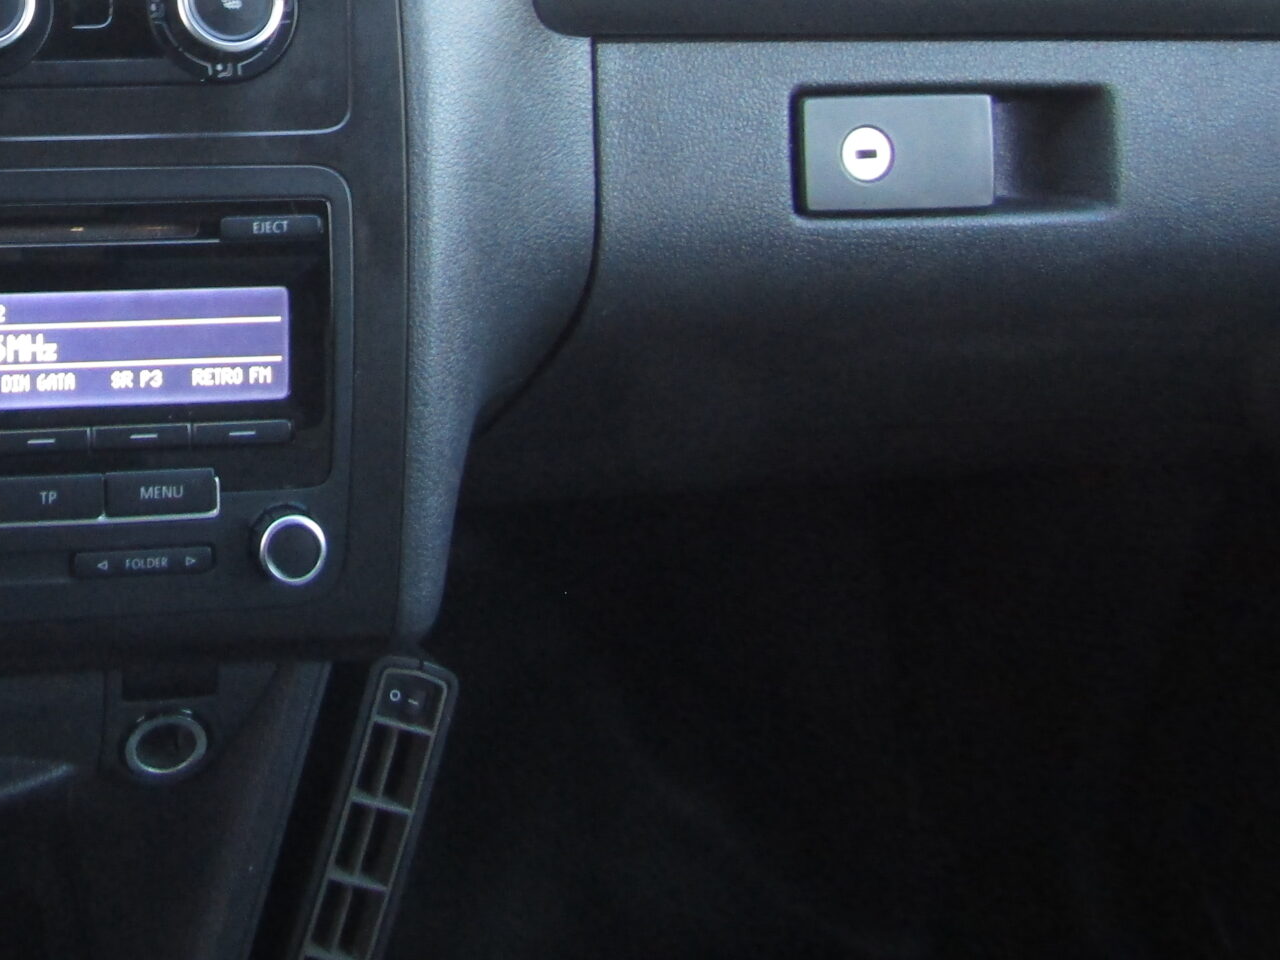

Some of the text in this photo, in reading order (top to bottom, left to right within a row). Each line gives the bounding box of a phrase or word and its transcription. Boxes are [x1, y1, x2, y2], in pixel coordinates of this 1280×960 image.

[251, 220, 289, 235] EJECT
[36, 372, 77, 391] GATA
[110, 368, 164, 389] SR P3
[191, 365, 273, 387] RETRO FM
[39, 489, 58, 506] TP
[139, 484, 185, 501] MENU
[125, 556, 169, 571] FOLDER
